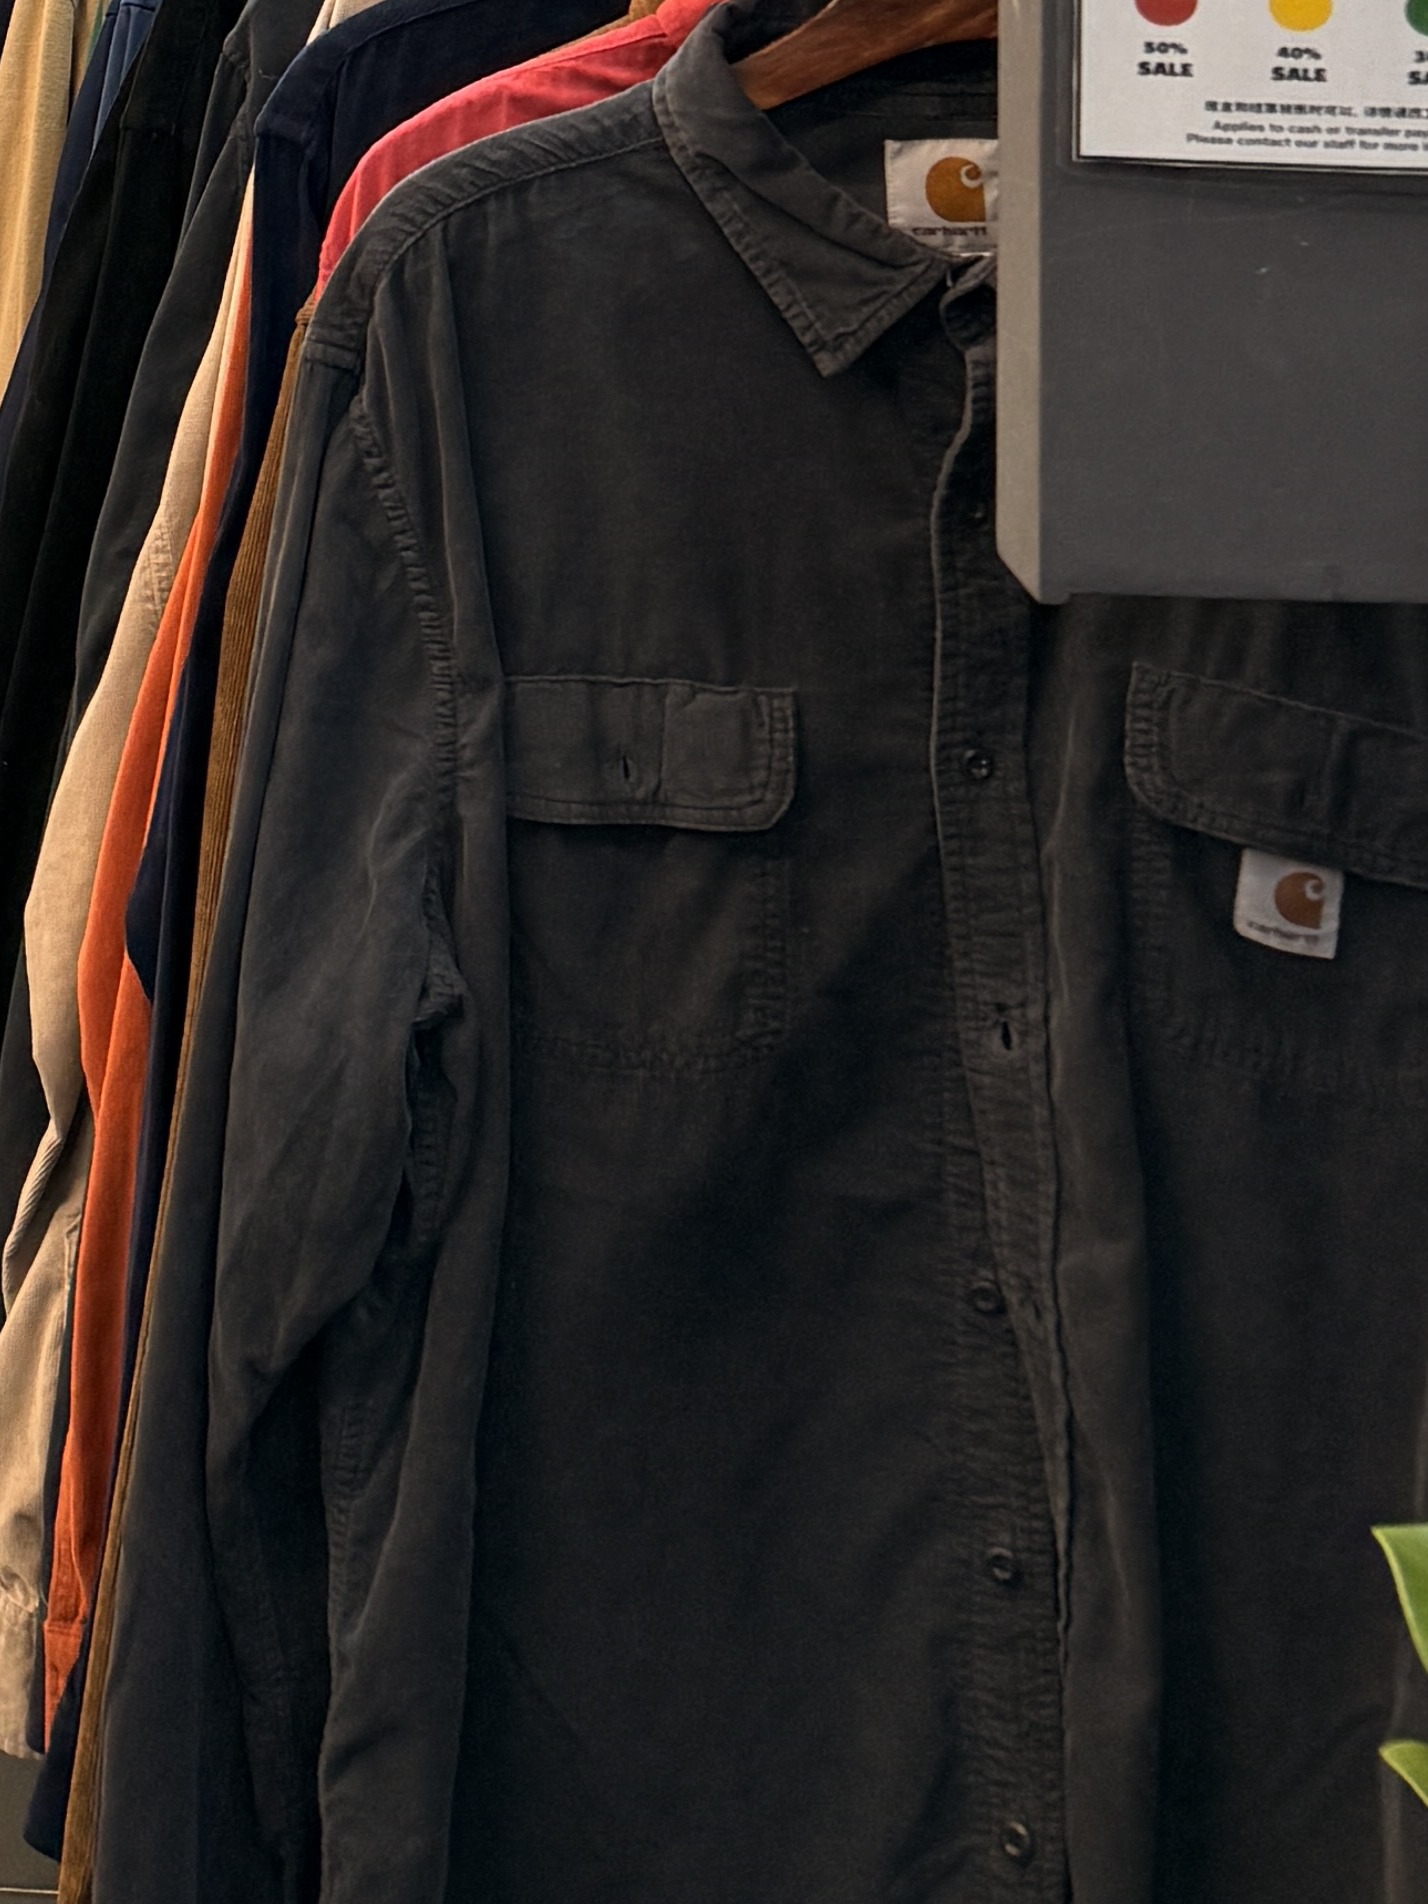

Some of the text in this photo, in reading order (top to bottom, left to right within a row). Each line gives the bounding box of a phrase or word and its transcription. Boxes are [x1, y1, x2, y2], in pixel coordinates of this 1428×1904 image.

[1143, 42, 1188, 55] 50%
[1276, 46, 1322, 60] 40%
[1137, 61, 1194, 77] SALE
[1271, 67, 1327, 83] SALE
